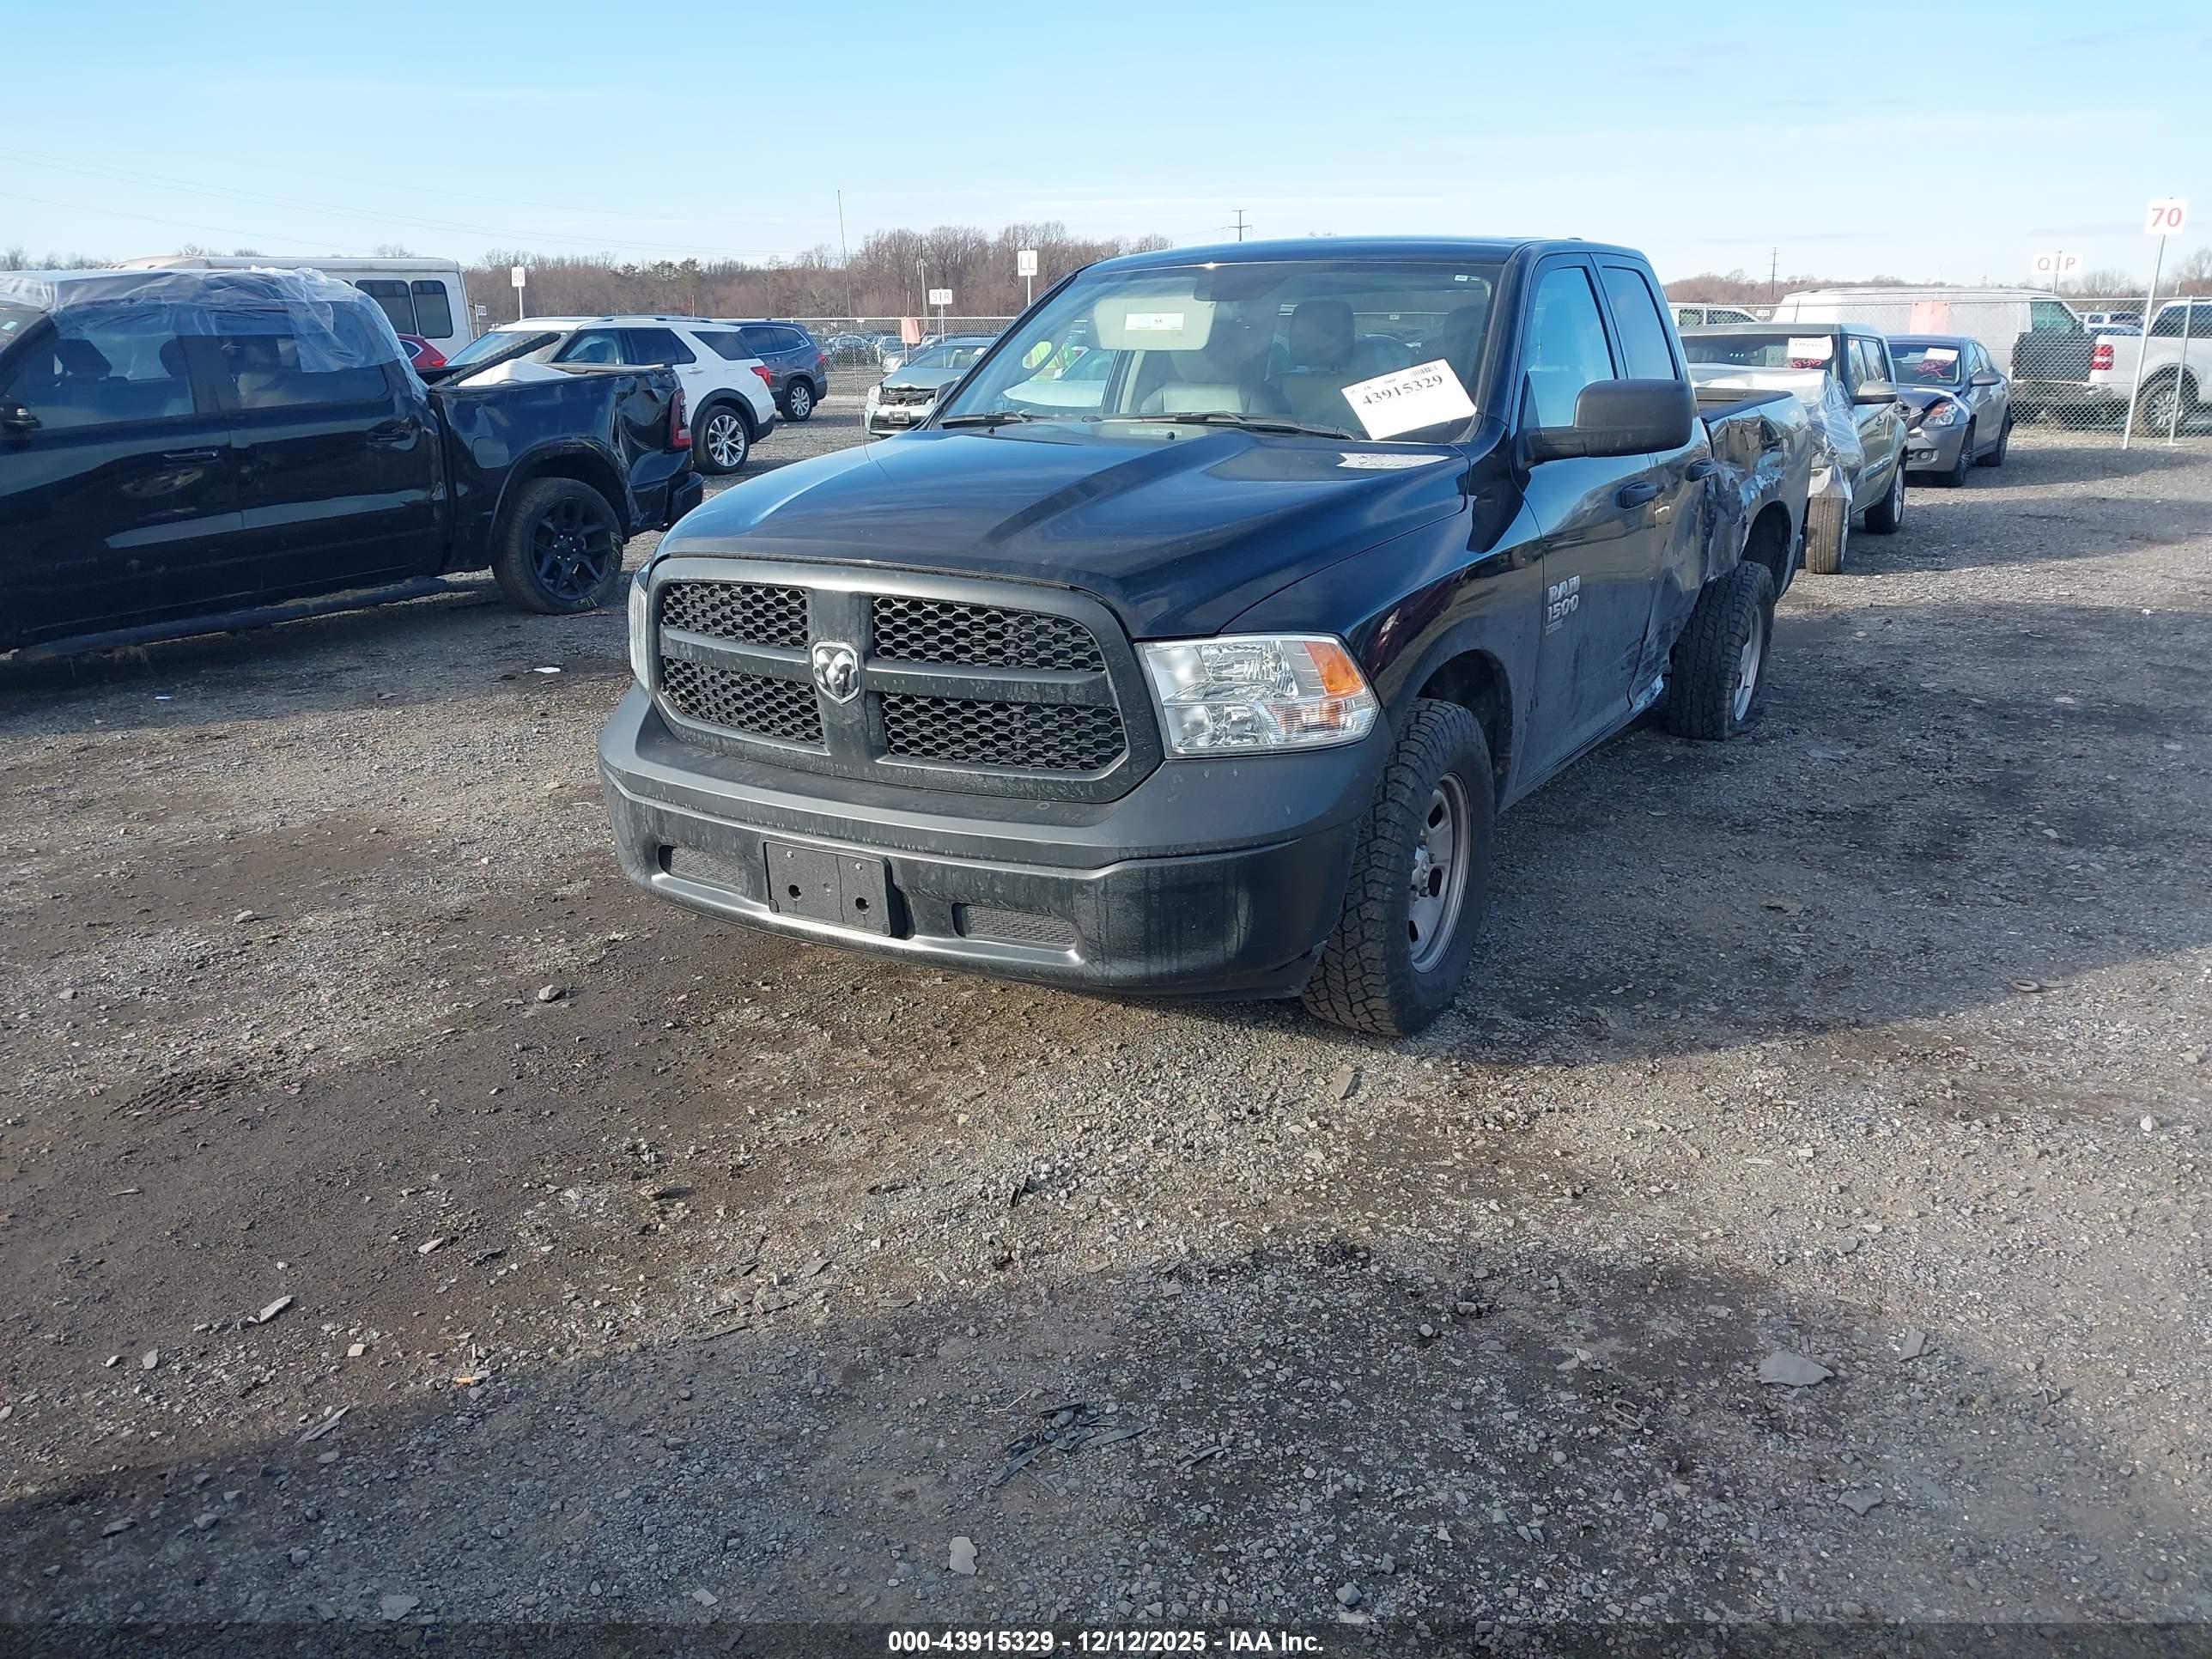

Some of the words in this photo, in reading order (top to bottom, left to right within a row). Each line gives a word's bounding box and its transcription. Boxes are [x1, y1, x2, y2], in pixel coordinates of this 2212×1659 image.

[2152, 207, 2182, 228] 70
[2038, 257, 2051, 270] Q
[2065, 257, 2075, 270] P
[1363, 374, 1443, 405] 43915329
[1547, 574, 1580, 604] RAM
[1547, 594, 1579, 623] 1500
